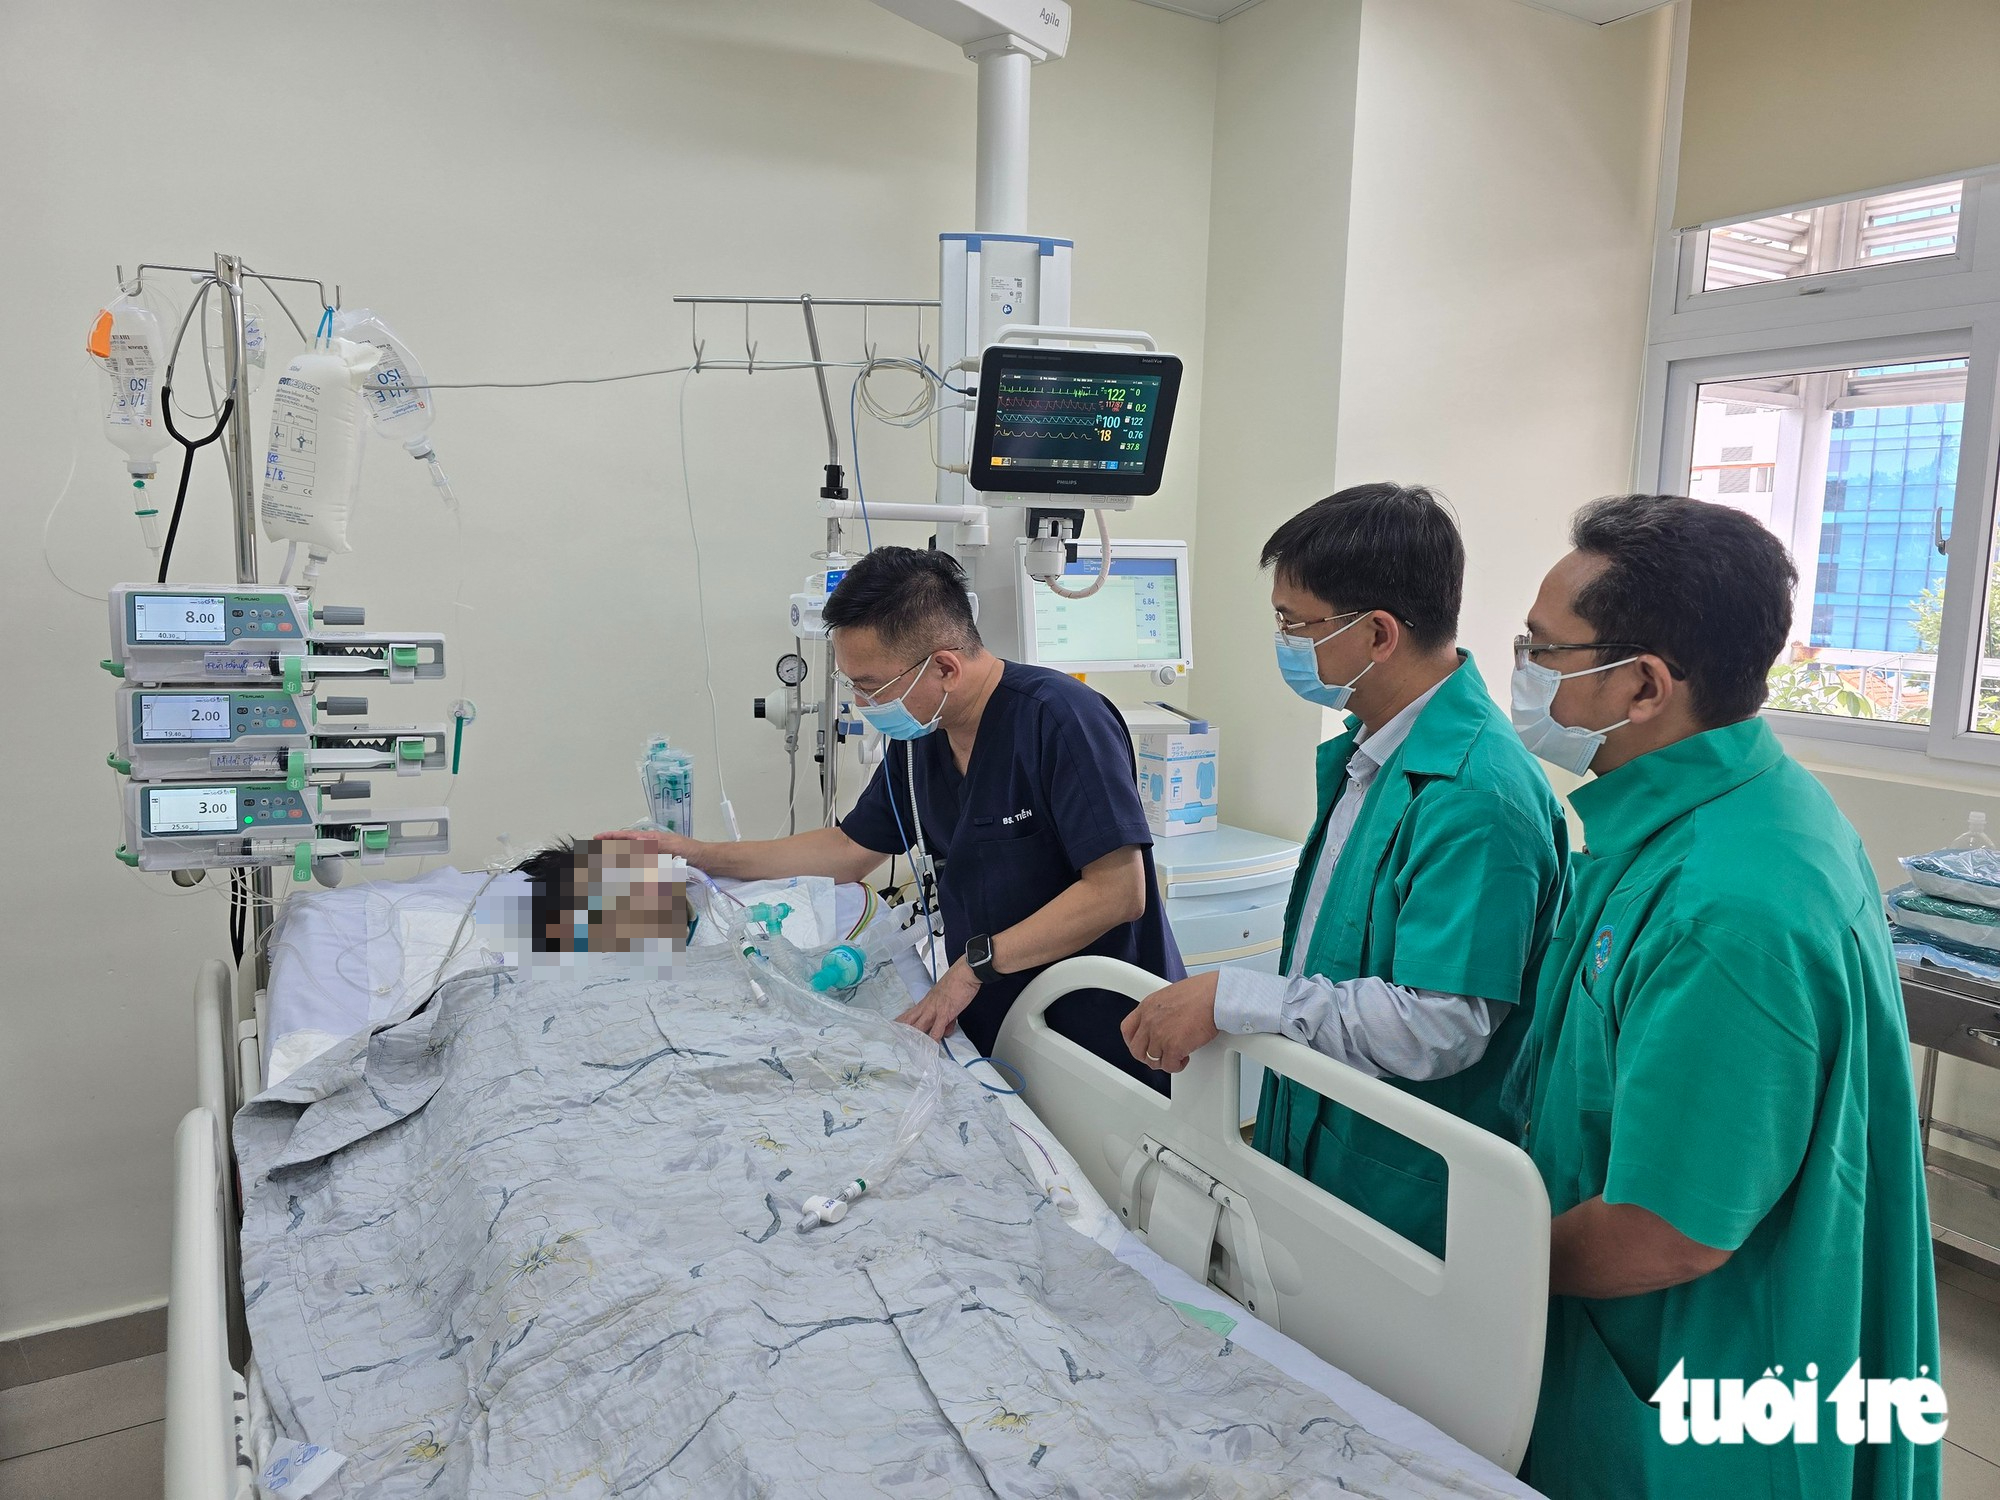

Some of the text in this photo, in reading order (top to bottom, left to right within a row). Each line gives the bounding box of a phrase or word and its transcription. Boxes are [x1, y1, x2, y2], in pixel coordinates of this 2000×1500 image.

[1039, 7, 1060, 27] Agila
[377, 368, 402, 385] ISO
[130, 378, 148, 391] ISO
[1107, 388, 1126, 401] 122
[1135, 388, 1141, 397] 0
[1135, 403, 1147, 412] 0.2
[1103, 416, 1120, 428] 100
[1131, 417, 1144, 426] 122
[1100, 429, 1112, 442] 18
[1128, 430, 1144, 439] 0.76
[1126, 443, 1140, 451] 37.8
[1147, 582, 1155, 590] 45
[1143, 597, 1155, 606] 6.84
[185, 610, 215, 623] 8.00
[1145, 613, 1156, 621] 390
[1149, 629, 1157, 637] 18
[191, 709, 220, 721] 2.00
[164, 730, 182, 738] 19.40
[1172, 785, 1180, 798] F
[198, 802, 228, 814] 3.00
